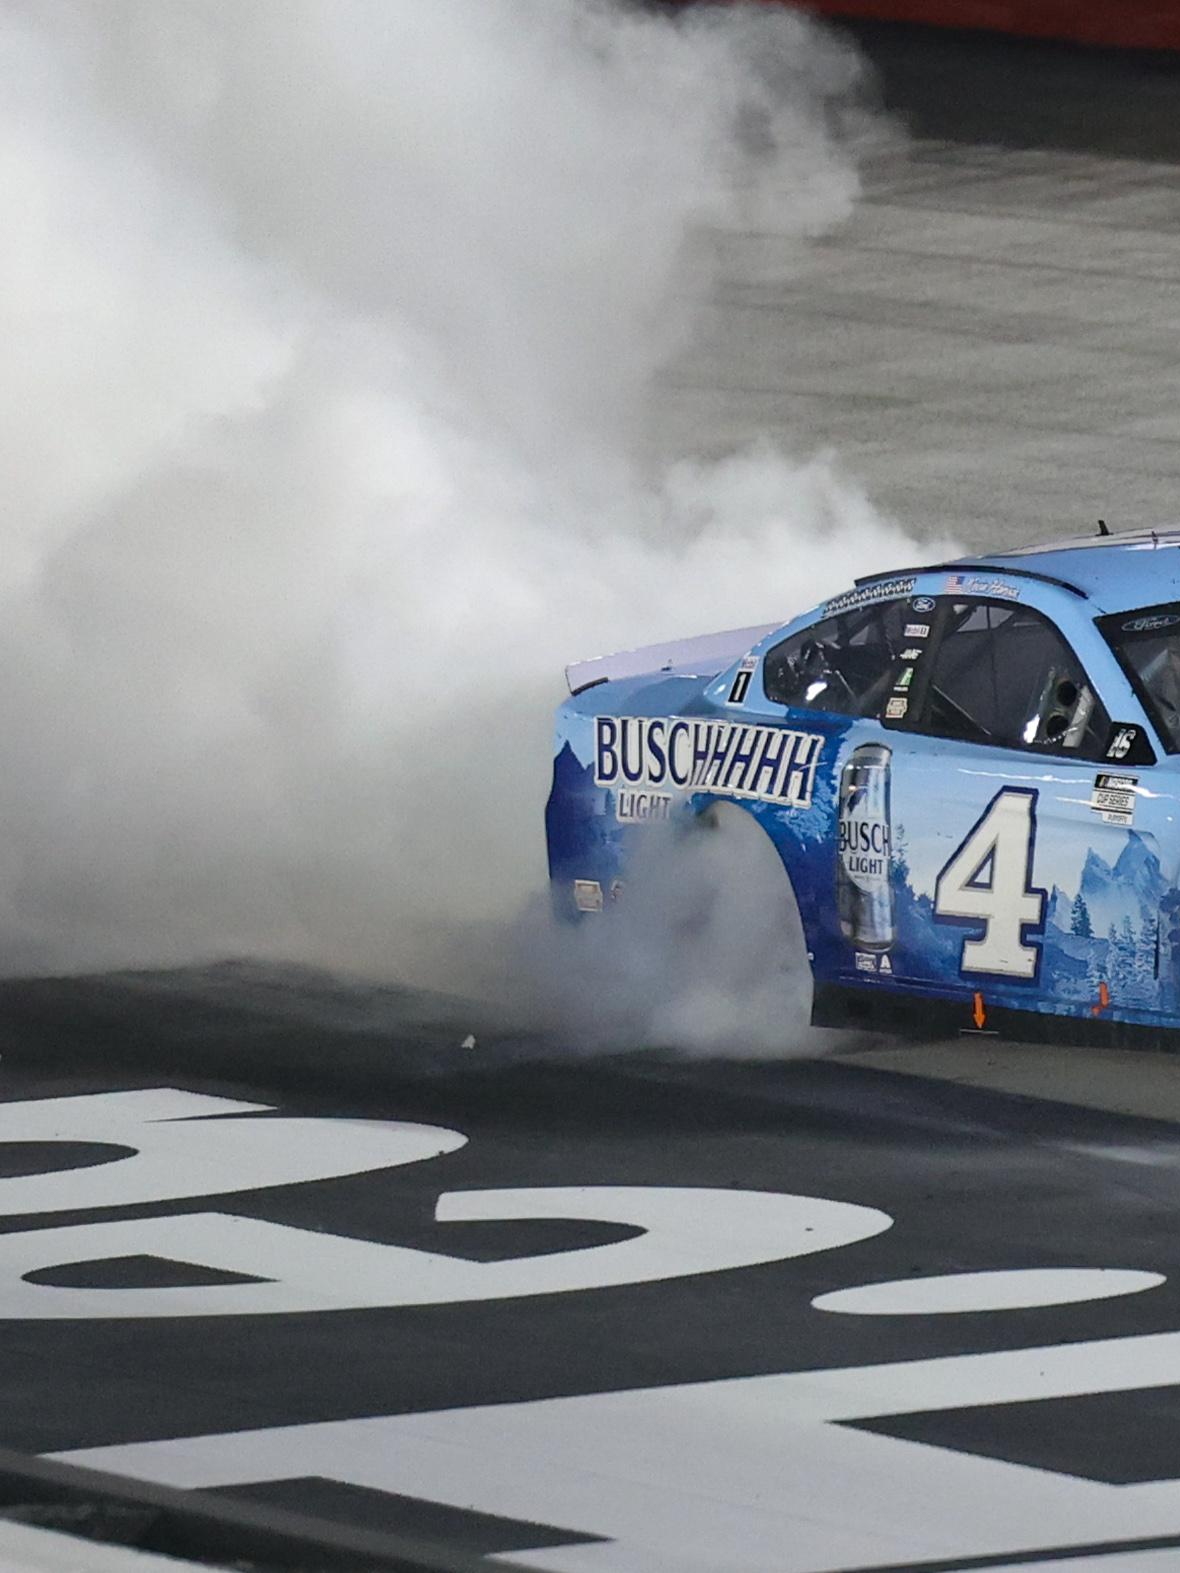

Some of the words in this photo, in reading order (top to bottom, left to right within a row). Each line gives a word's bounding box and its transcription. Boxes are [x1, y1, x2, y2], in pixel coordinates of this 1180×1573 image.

[620, 792, 670, 818] LIGHT
[840, 822, 889, 857] BUSCH
[849, 856, 884, 874] LIGHT
[935, 787, 1047, 982] 4
